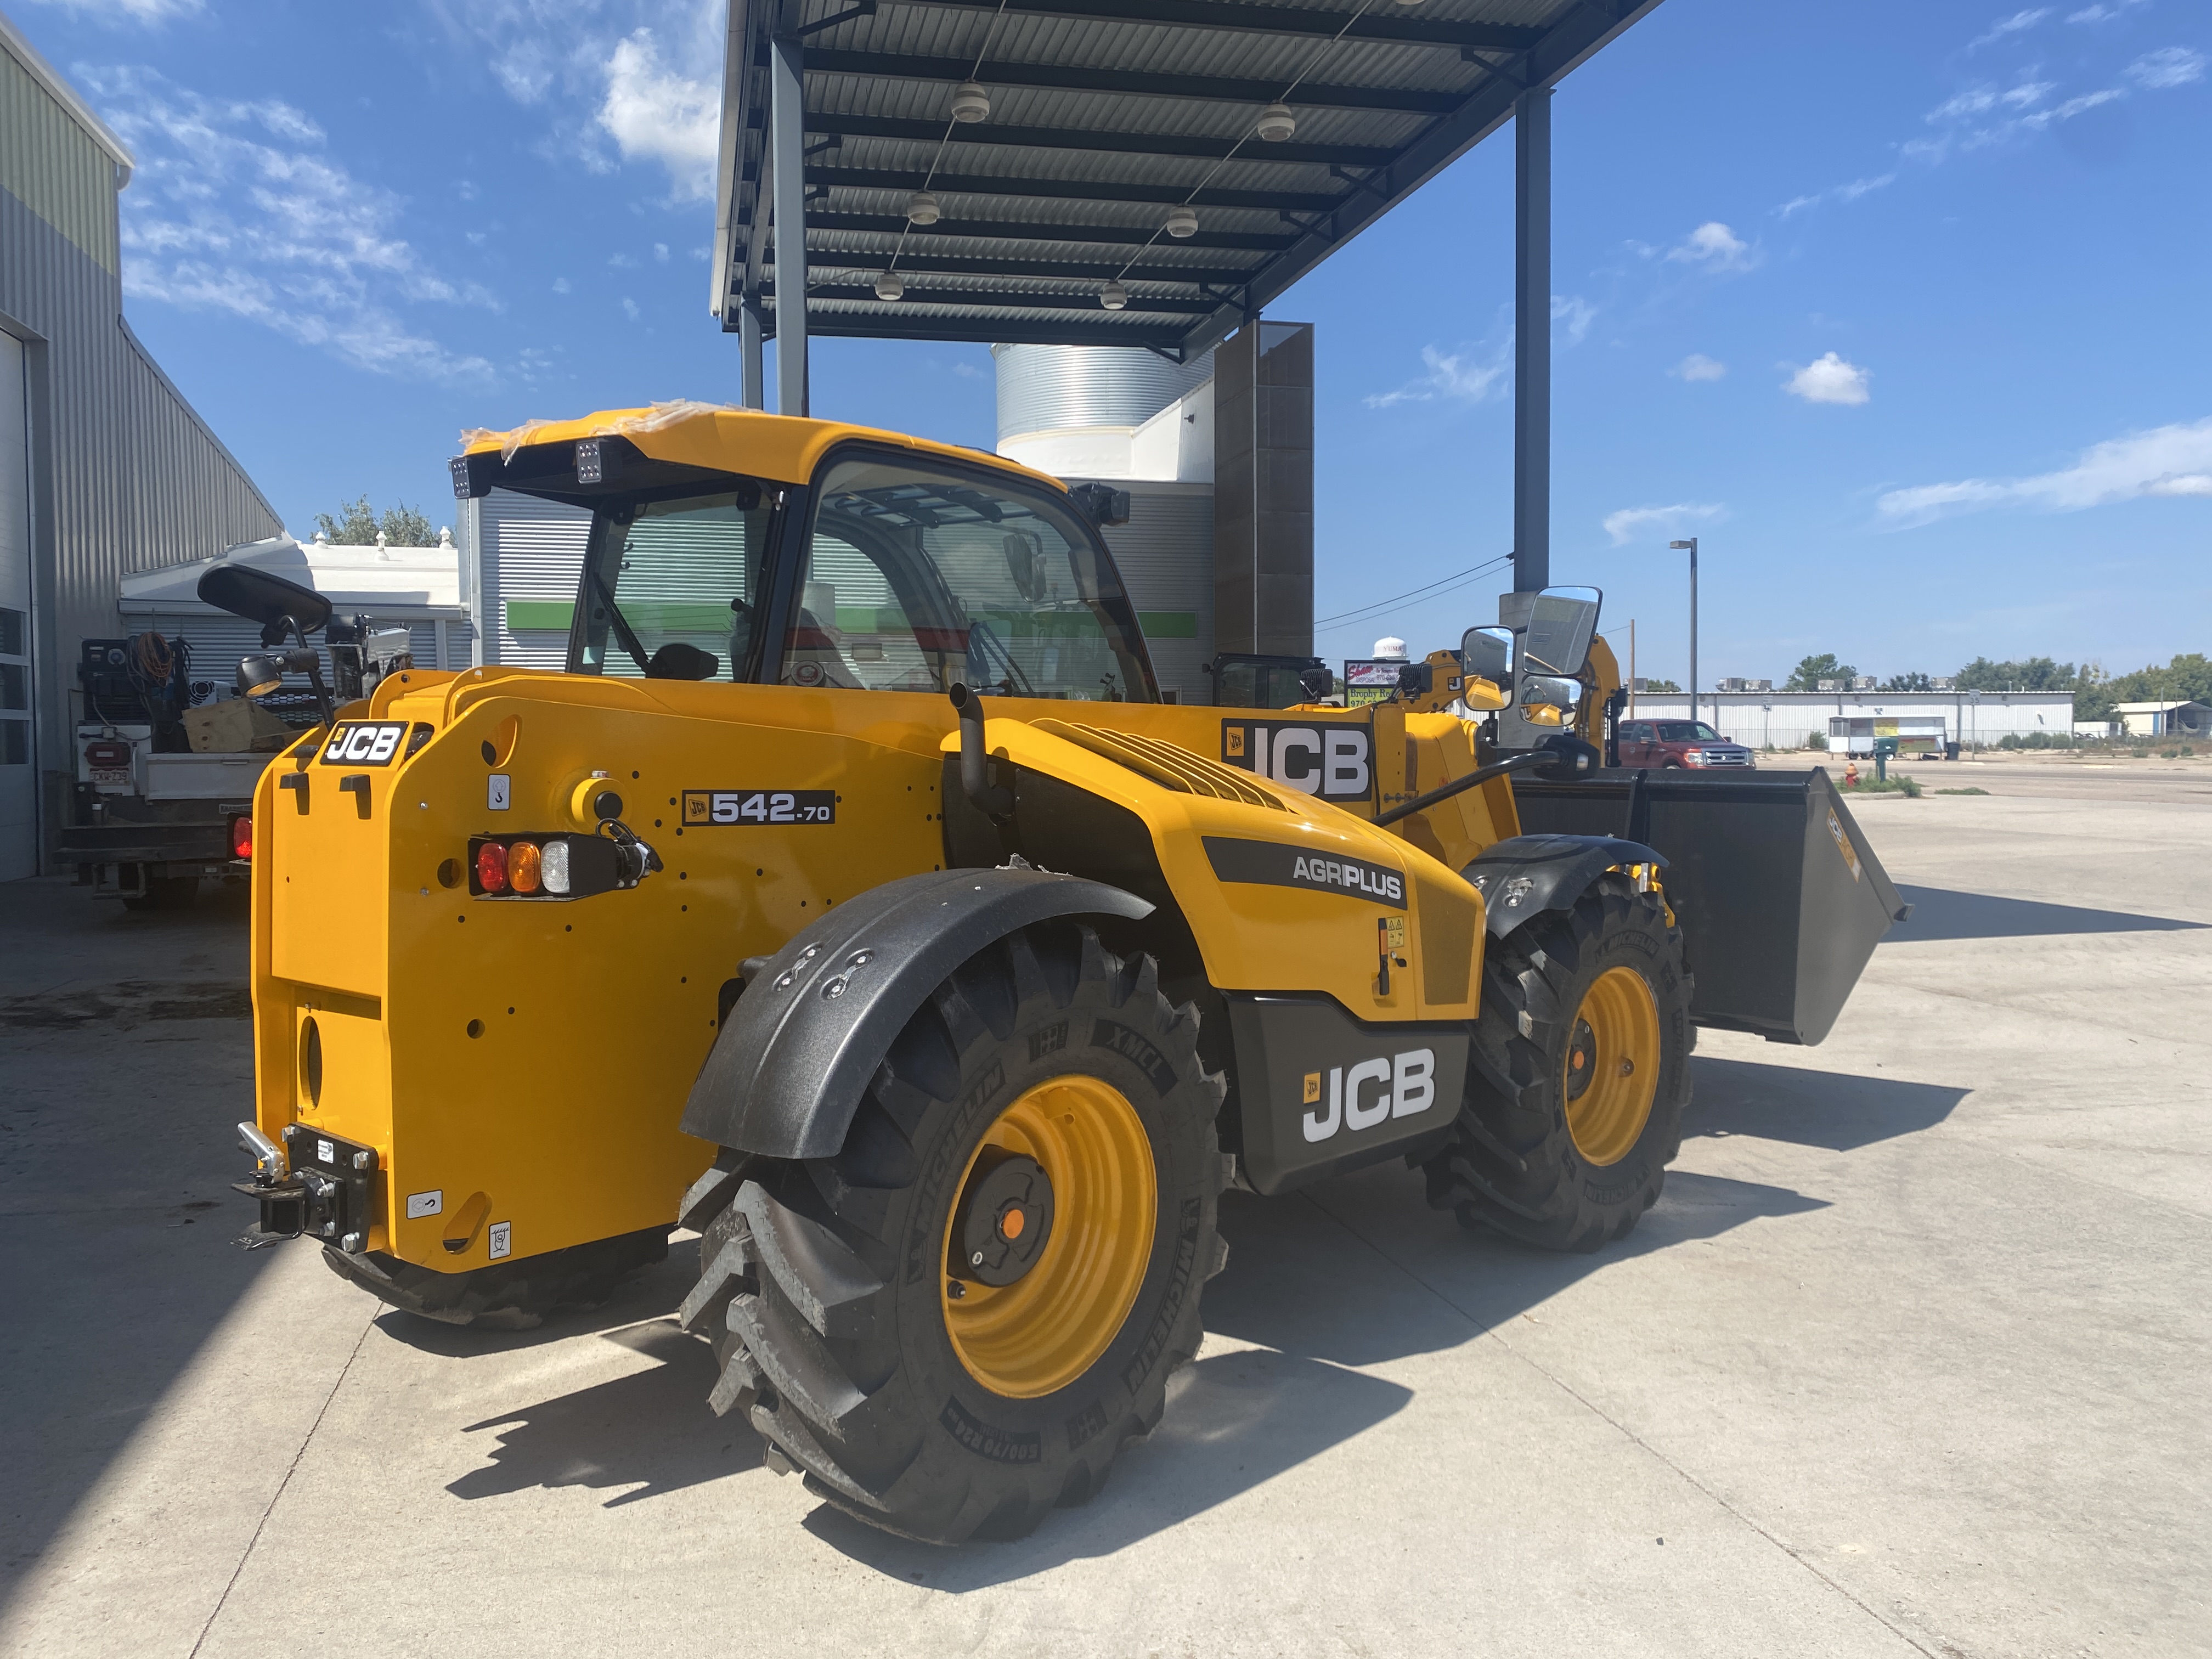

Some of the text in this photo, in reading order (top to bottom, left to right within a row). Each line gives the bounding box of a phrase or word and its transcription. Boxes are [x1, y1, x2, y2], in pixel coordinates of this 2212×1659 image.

[1348, 663, 1374, 680] Shaw
[1350, 689, 1377, 700] Brophy
[326, 727, 401, 760] JCB
[1231, 733, 1242, 749] JCB
[691, 802, 706, 815] JCB
[1829, 816, 1843, 844] JCB
[1105, 1025, 1163, 1079] XMCL
[1304, 1048, 1435, 1143] JCB
[1307, 1081, 1318, 1096] JCB
